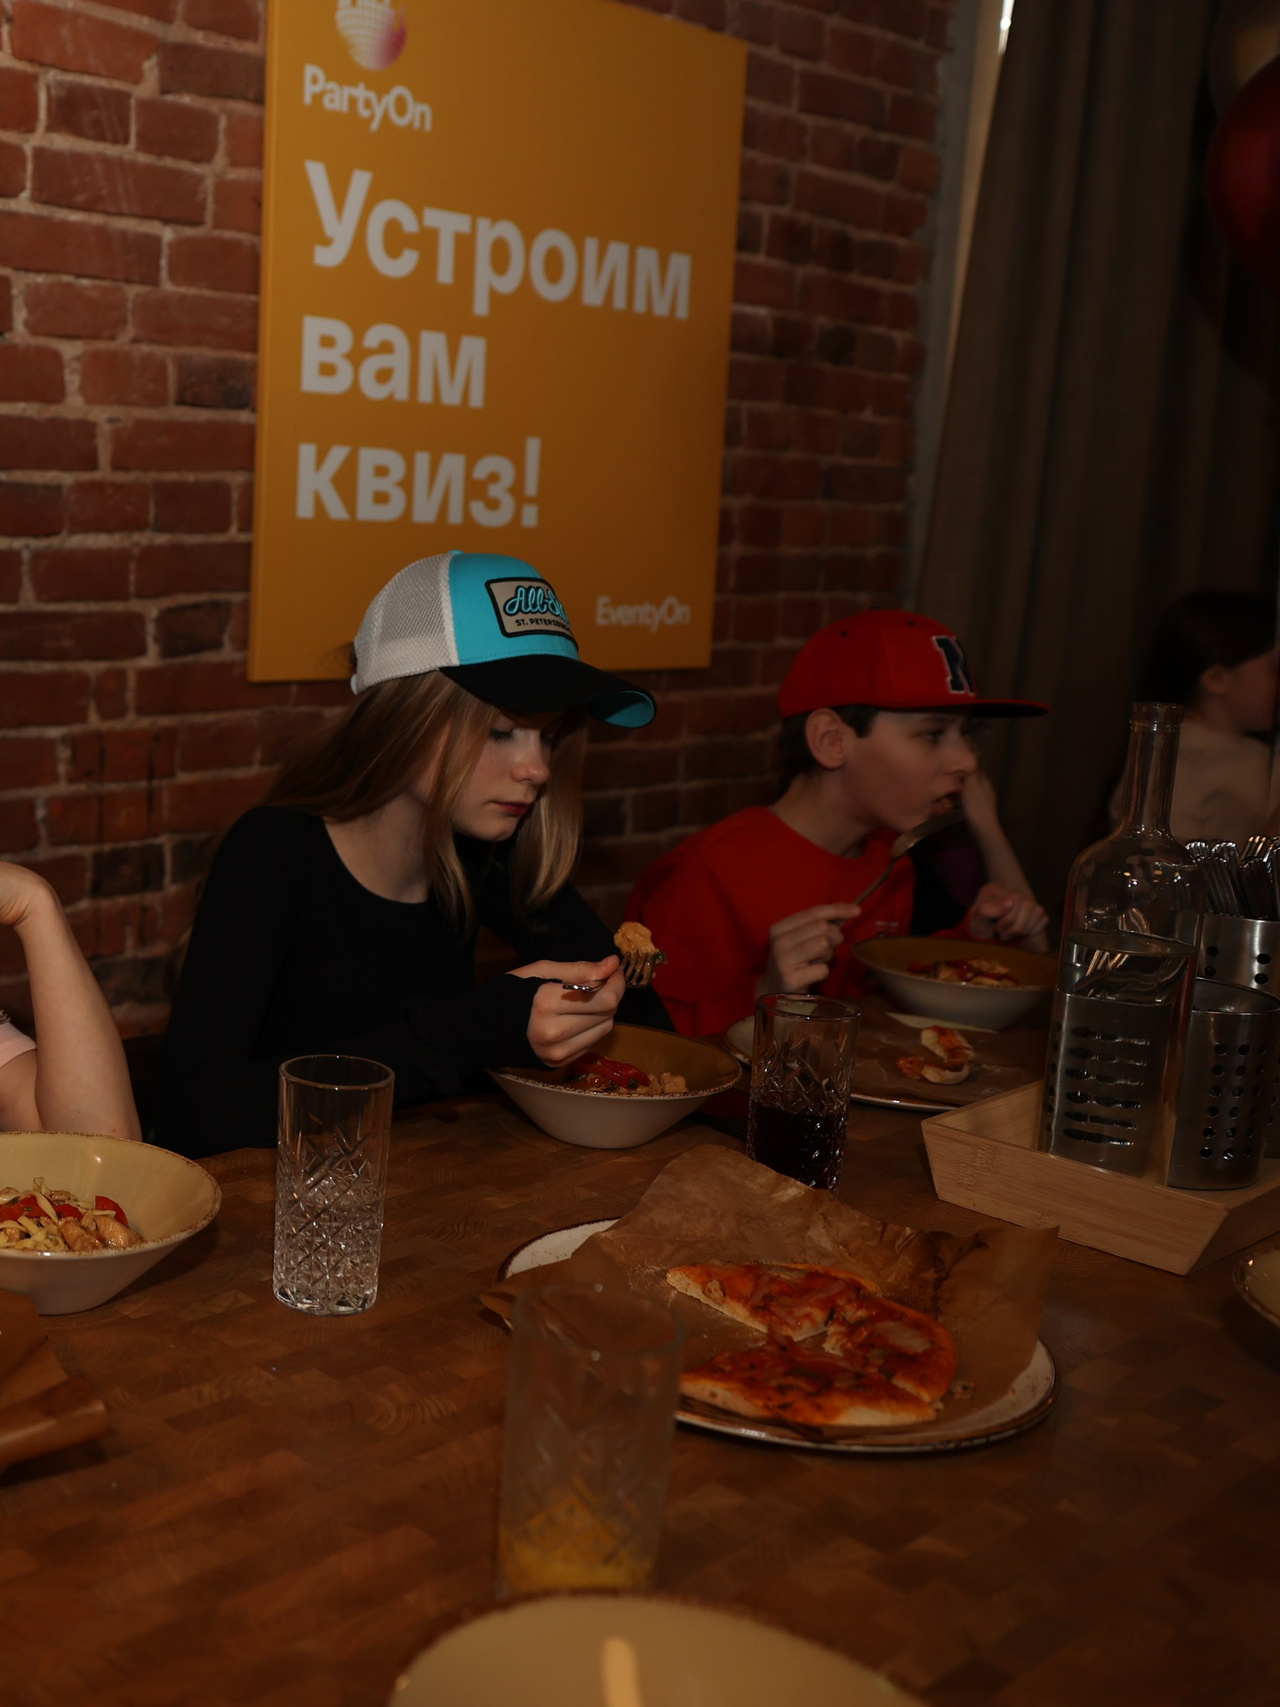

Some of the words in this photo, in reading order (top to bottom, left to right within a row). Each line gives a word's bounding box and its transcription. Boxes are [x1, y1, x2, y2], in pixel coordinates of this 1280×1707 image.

[303, 62, 433, 133] PartyOn
[304, 158, 692, 321] Устроим
[300, 314, 487, 409] вам
[295, 436, 542, 529] квиз!
[515, 618, 529, 627] ST.
[595, 595, 692, 636] EventyOn
